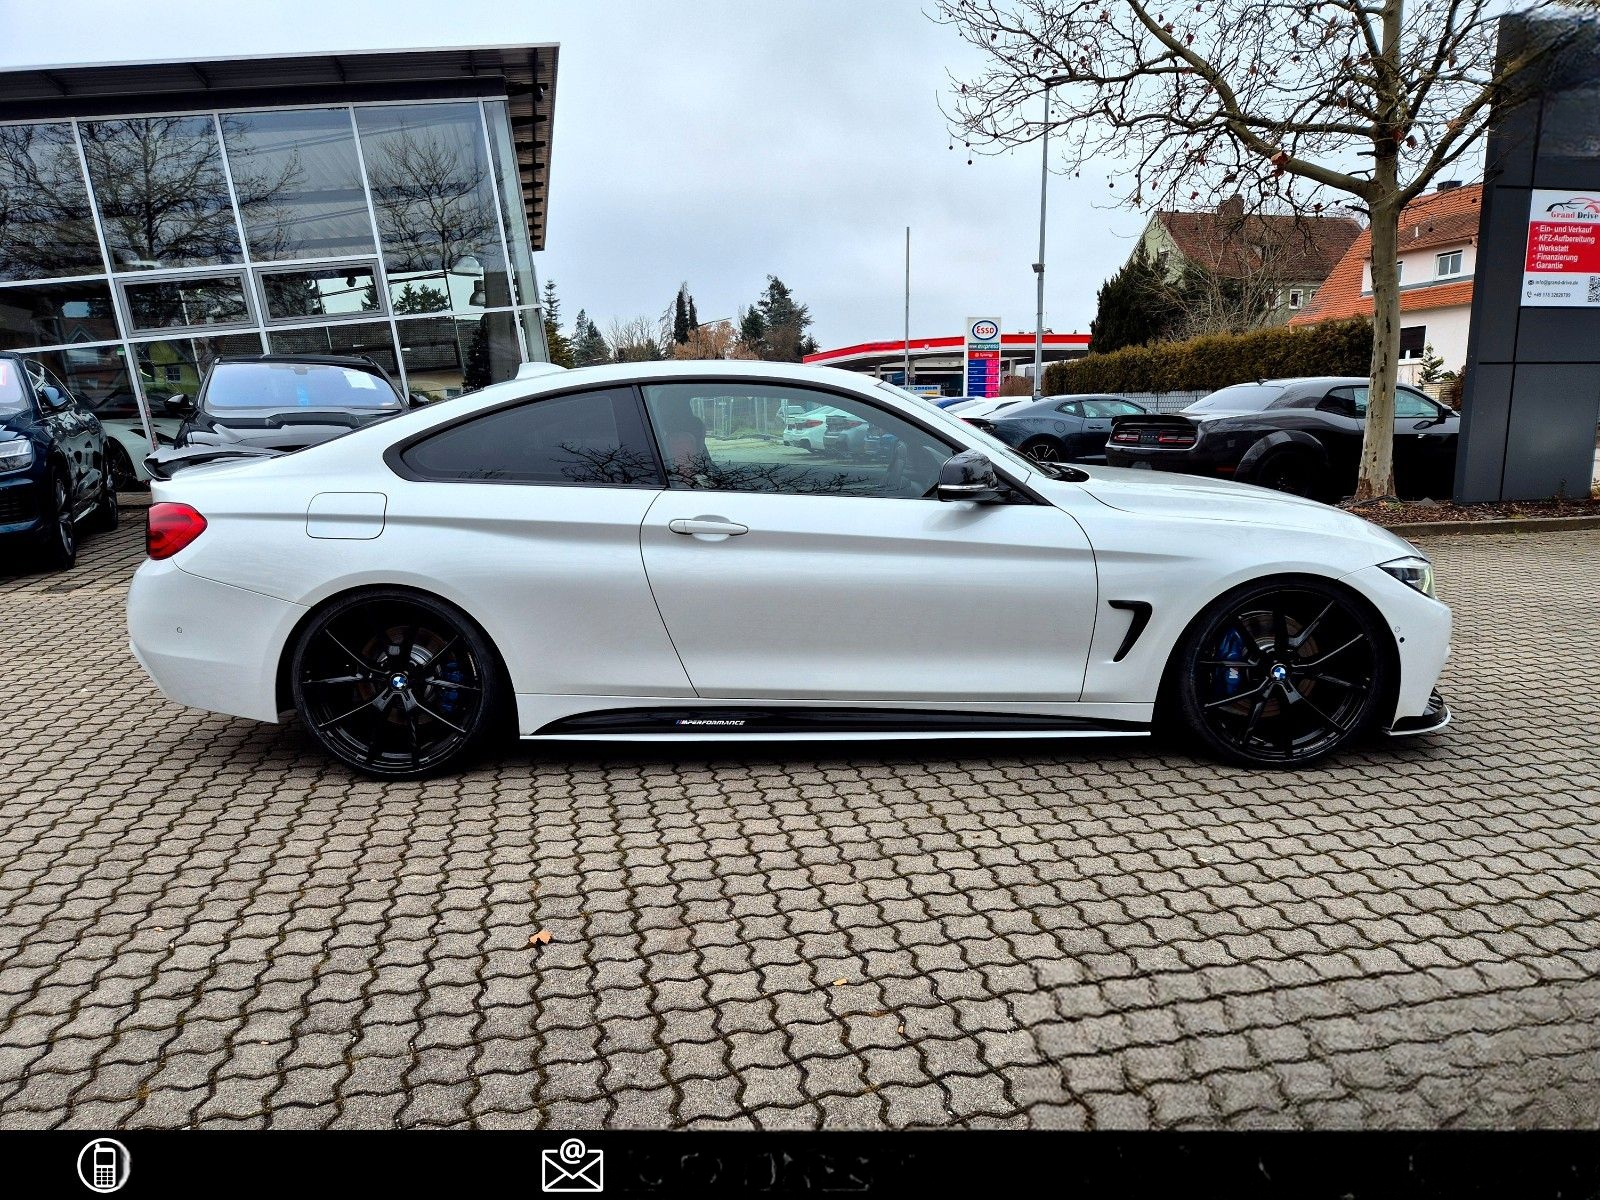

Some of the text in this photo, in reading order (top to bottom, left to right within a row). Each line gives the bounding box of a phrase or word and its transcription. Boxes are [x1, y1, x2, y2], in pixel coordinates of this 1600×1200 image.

[1538, 234, 1596, 244] KFZ-Aufbereitung
[1538, 244, 1569, 252] Werkstatt
[1537, 252, 1578, 262] Finanzierung
[1536, 261, 1563, 269] Garantie
